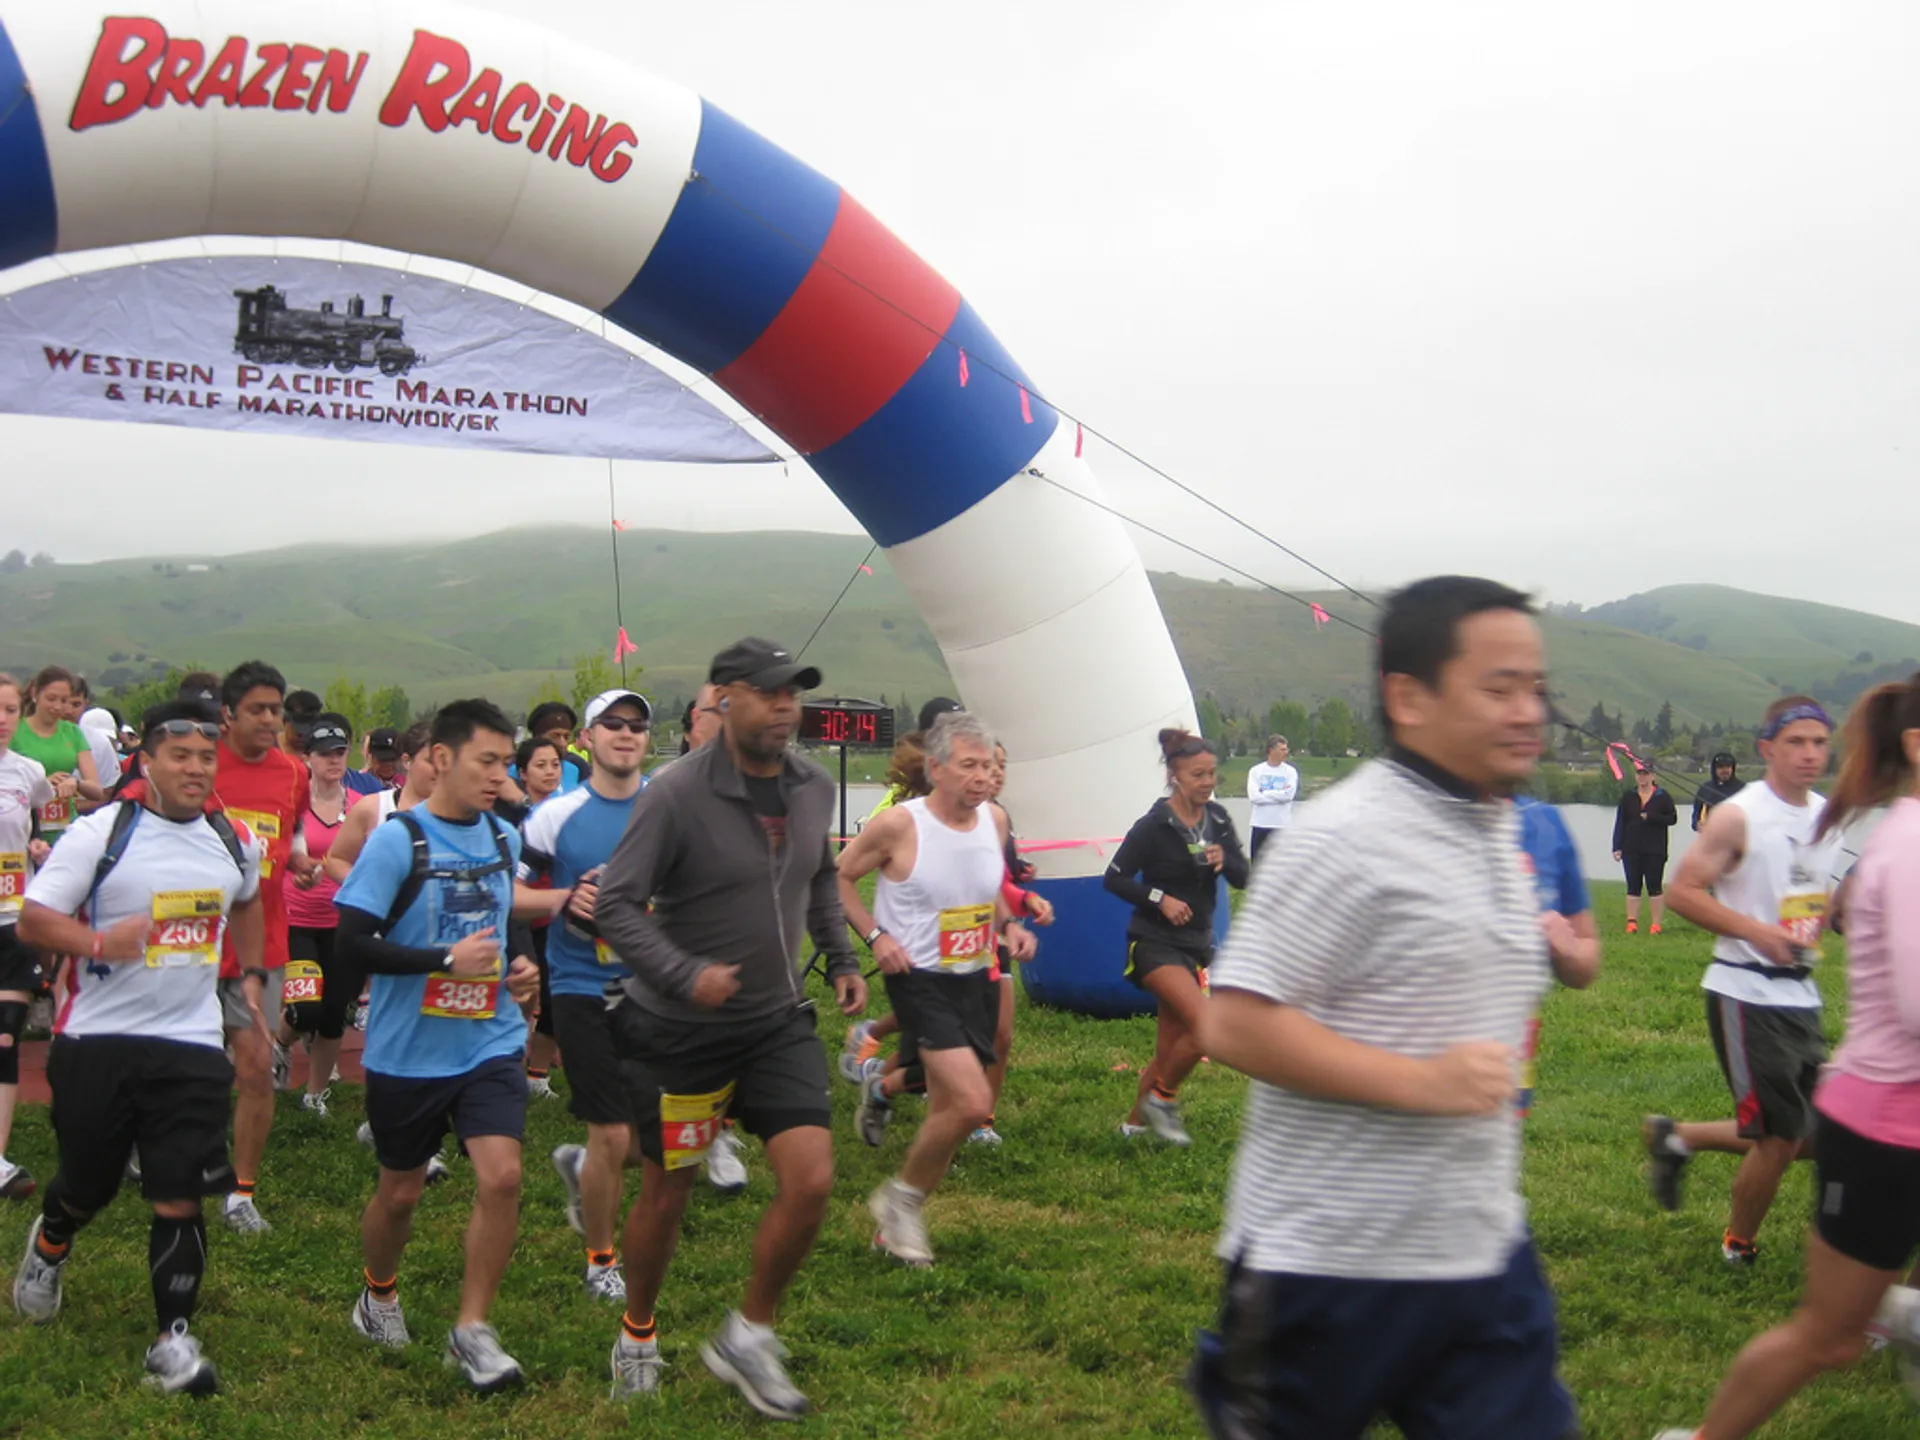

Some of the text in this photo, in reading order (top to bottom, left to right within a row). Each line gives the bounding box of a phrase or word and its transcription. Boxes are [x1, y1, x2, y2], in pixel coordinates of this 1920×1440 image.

[69, 15, 369, 132] BRAZEN
[43, 346, 589, 417] WESTERN PACIFIC MARATHON
[105, 383, 125, 401] &
[144, 386, 222, 409] HALF
[820, 709, 876, 742] 30:14
[159, 917, 209, 945] 256
[285, 978, 317, 999] 334
[435, 980, 489, 1011] 388
